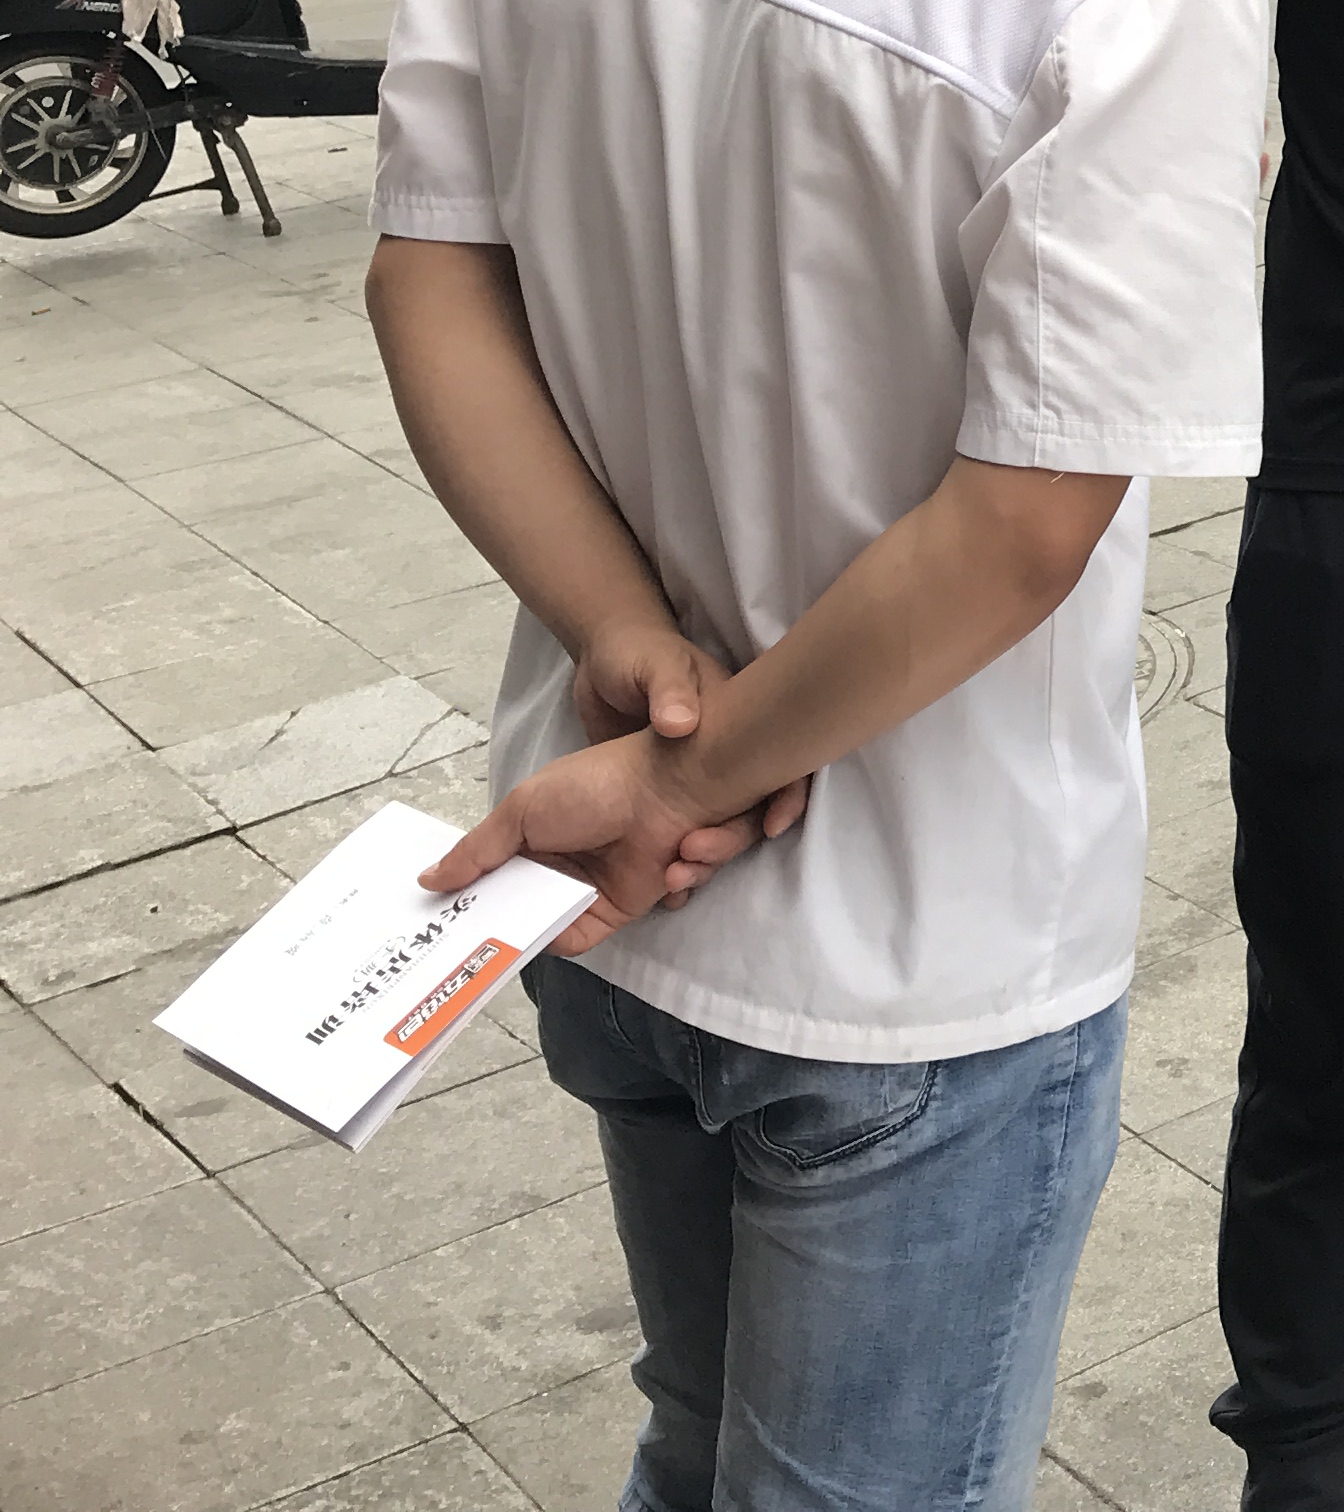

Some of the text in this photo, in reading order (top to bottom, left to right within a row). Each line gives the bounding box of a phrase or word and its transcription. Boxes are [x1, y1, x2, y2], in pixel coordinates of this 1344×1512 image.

[305, 889, 477, 1046] 实体店培训
